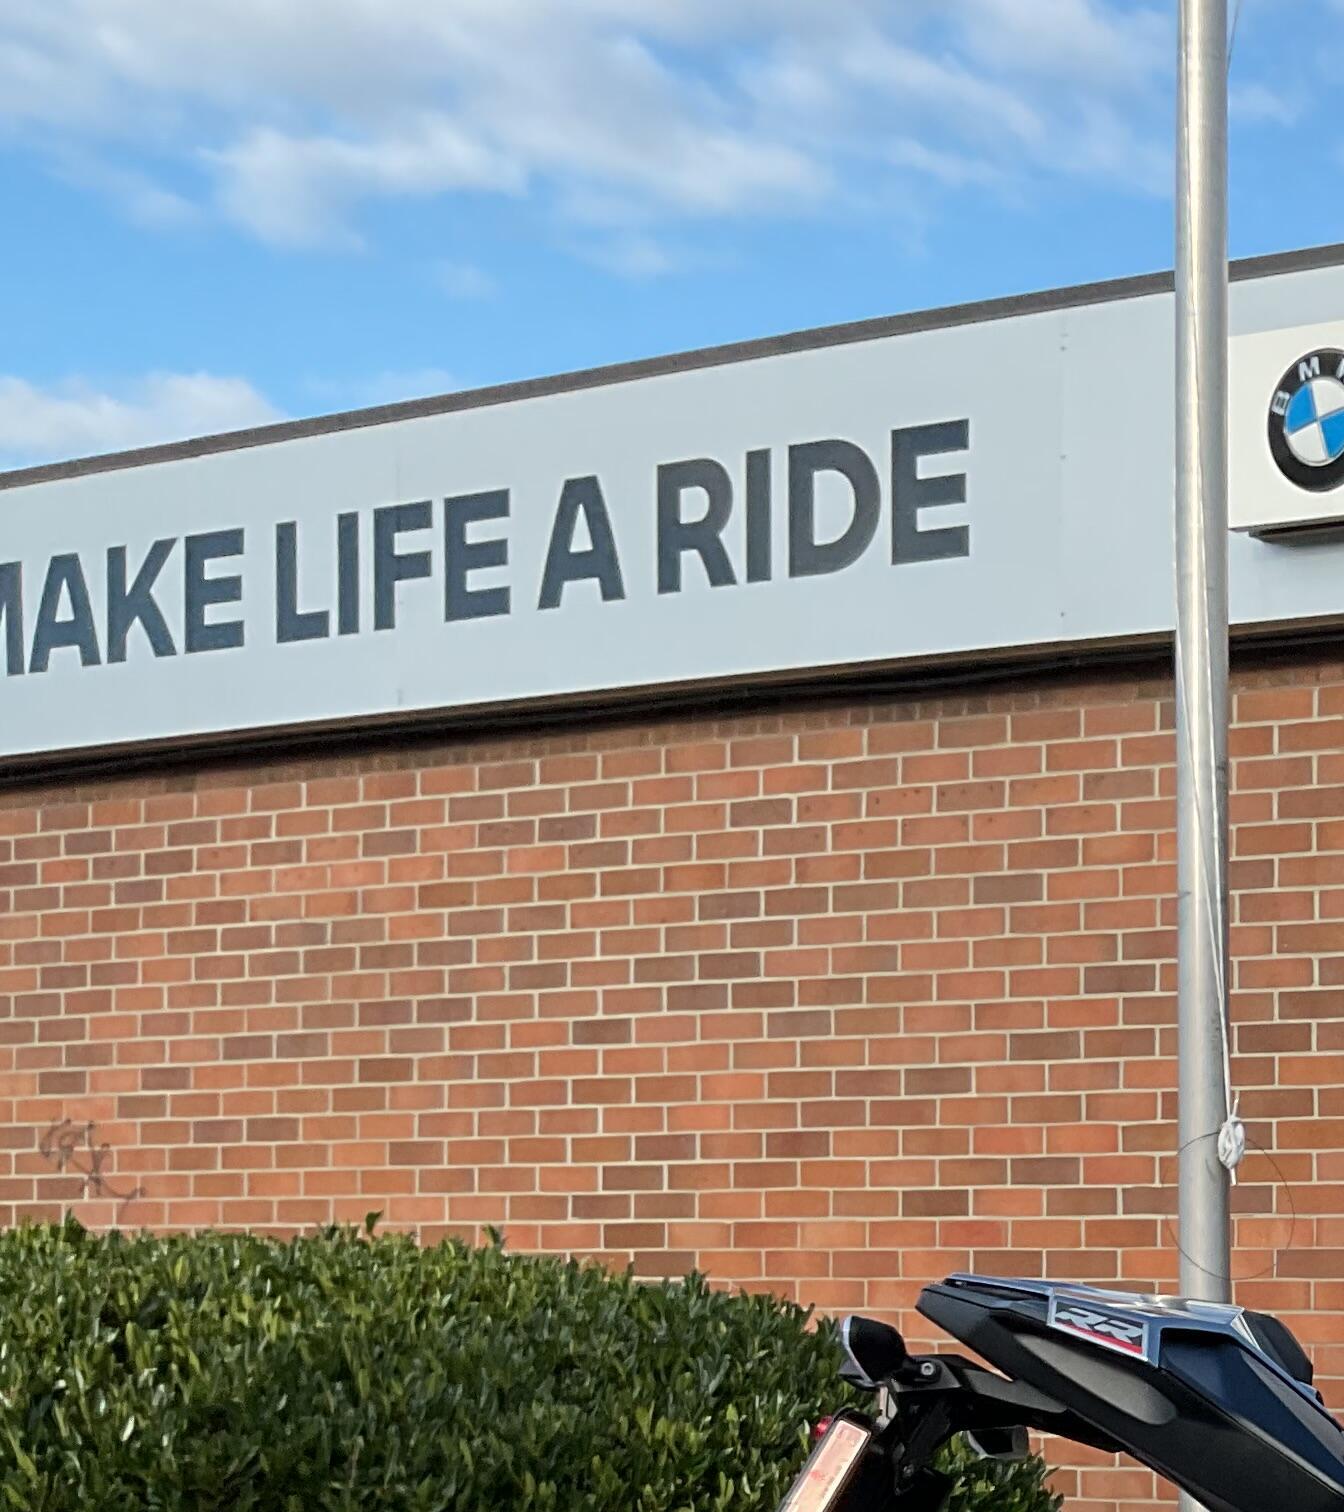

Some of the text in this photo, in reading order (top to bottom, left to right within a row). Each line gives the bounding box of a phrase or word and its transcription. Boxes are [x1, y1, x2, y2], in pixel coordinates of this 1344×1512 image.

[0, 418, 970, 677] AKE LIFE A RIDE
[1054, 1307, 1143, 1345] RR
